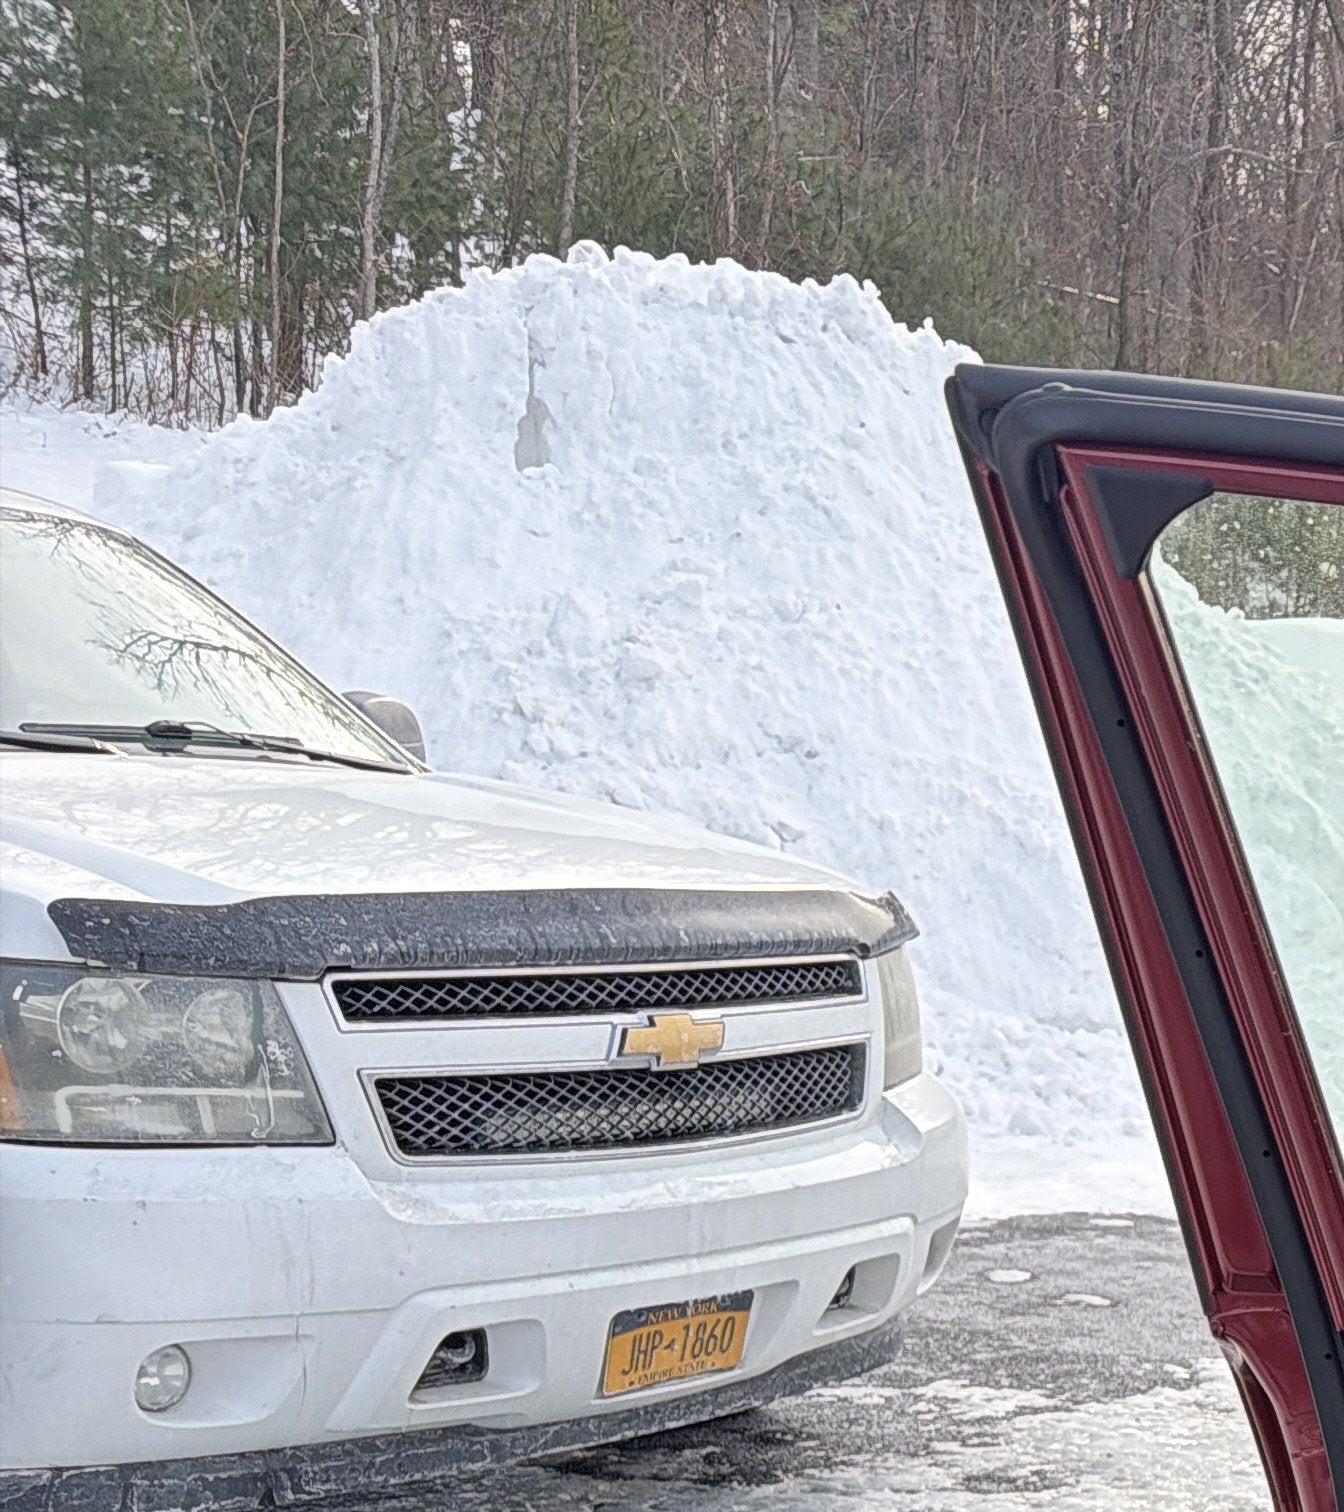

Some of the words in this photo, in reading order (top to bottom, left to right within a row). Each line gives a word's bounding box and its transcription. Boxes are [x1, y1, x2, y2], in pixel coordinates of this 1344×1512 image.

[648, 1306, 682, 1325] NEW
[686, 1301, 719, 1319] YORK
[621, 1329, 665, 1376] JHP
[679, 1315, 736, 1362] 1860
